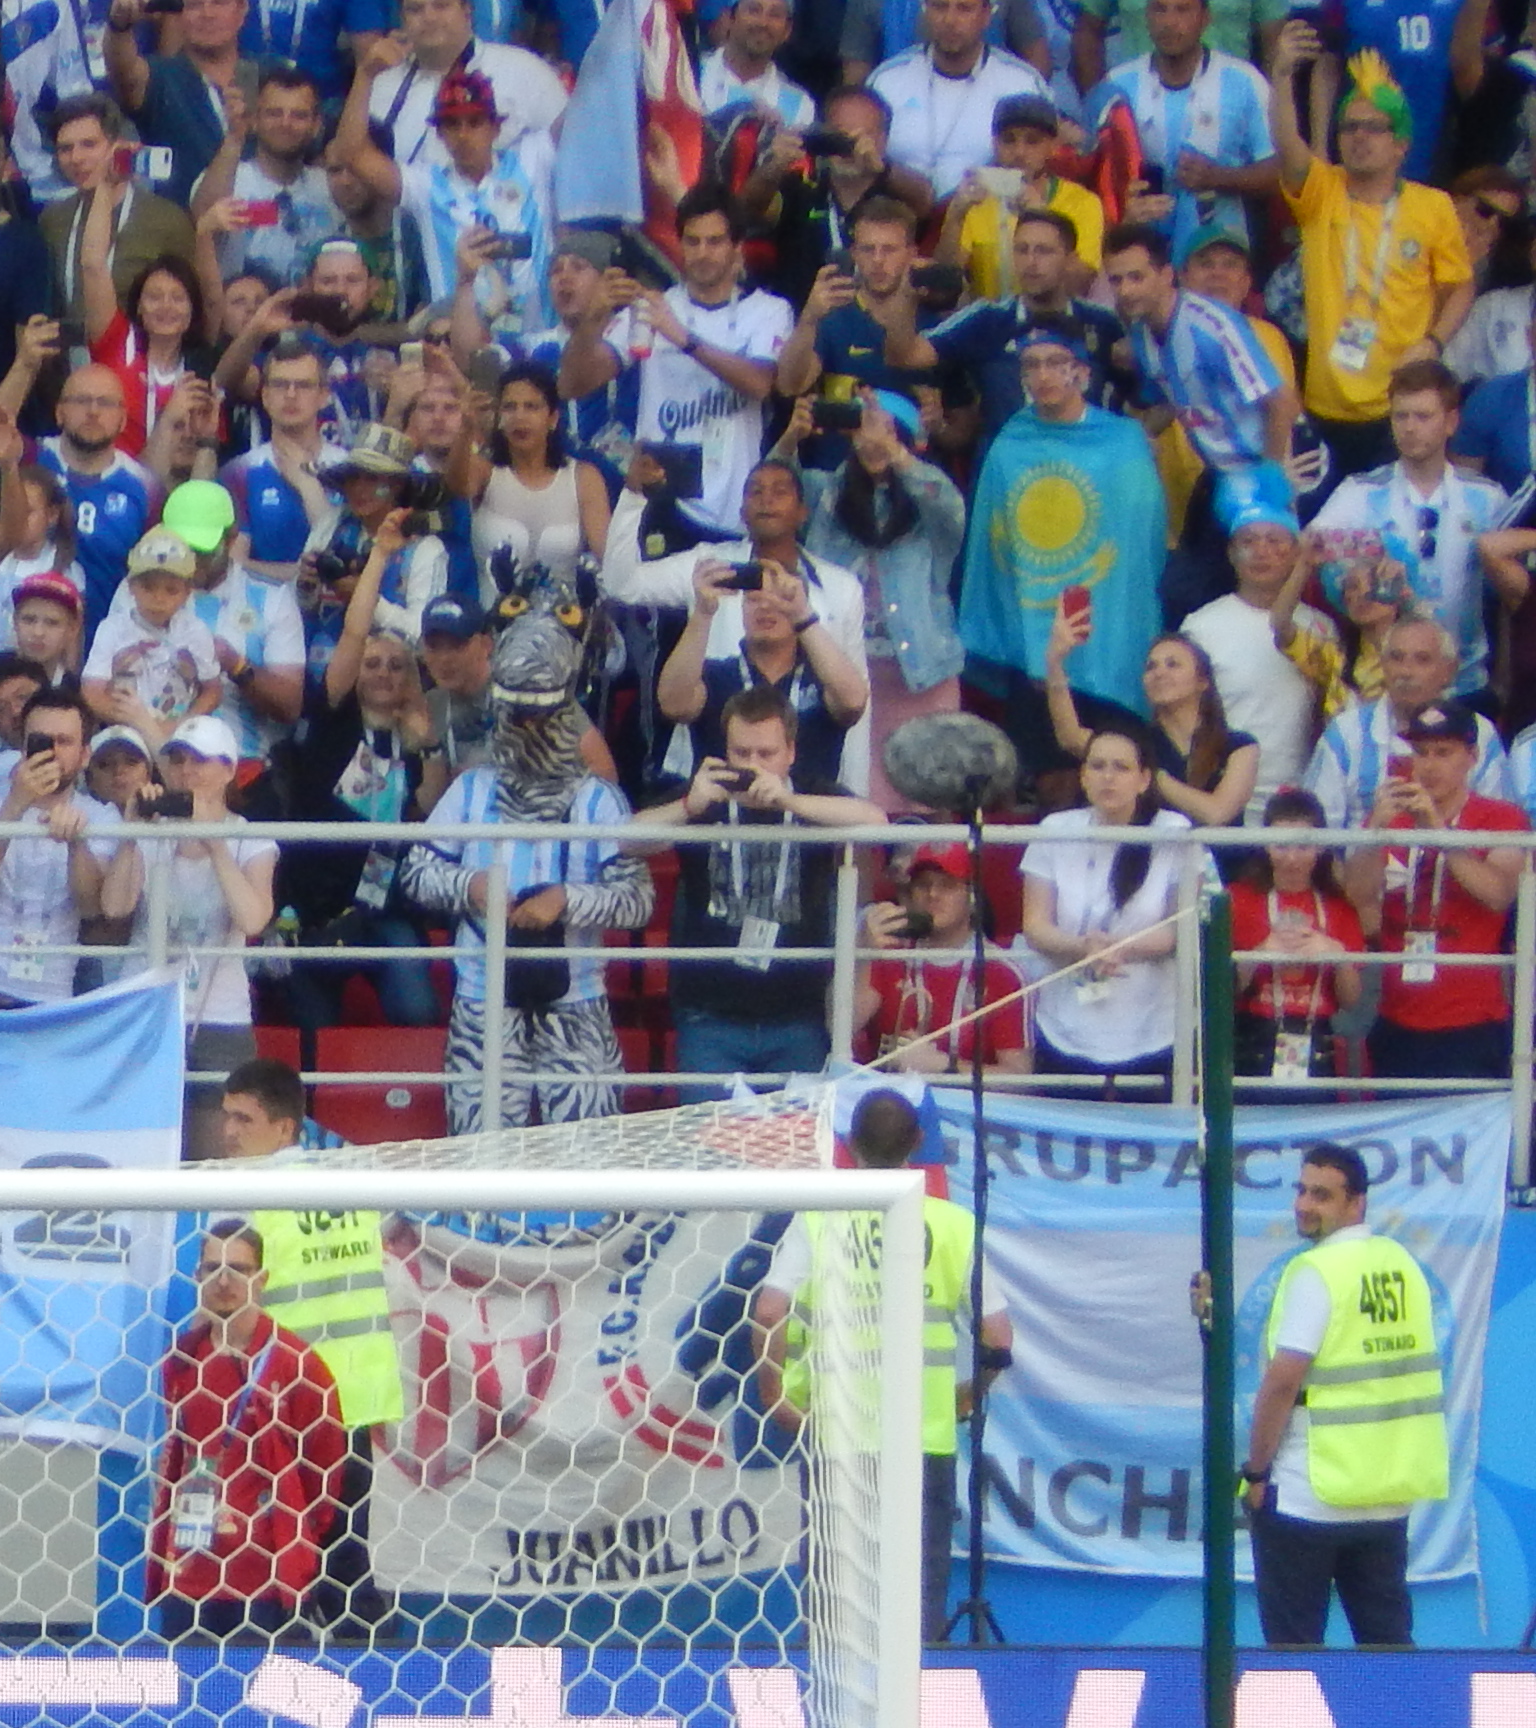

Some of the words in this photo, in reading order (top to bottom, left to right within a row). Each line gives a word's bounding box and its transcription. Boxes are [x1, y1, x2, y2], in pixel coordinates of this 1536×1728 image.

[1398, 14, 1431, 50] 10
[77, 501, 96, 535] 8
[490, 1498, 760, 1588] JUANILLO
